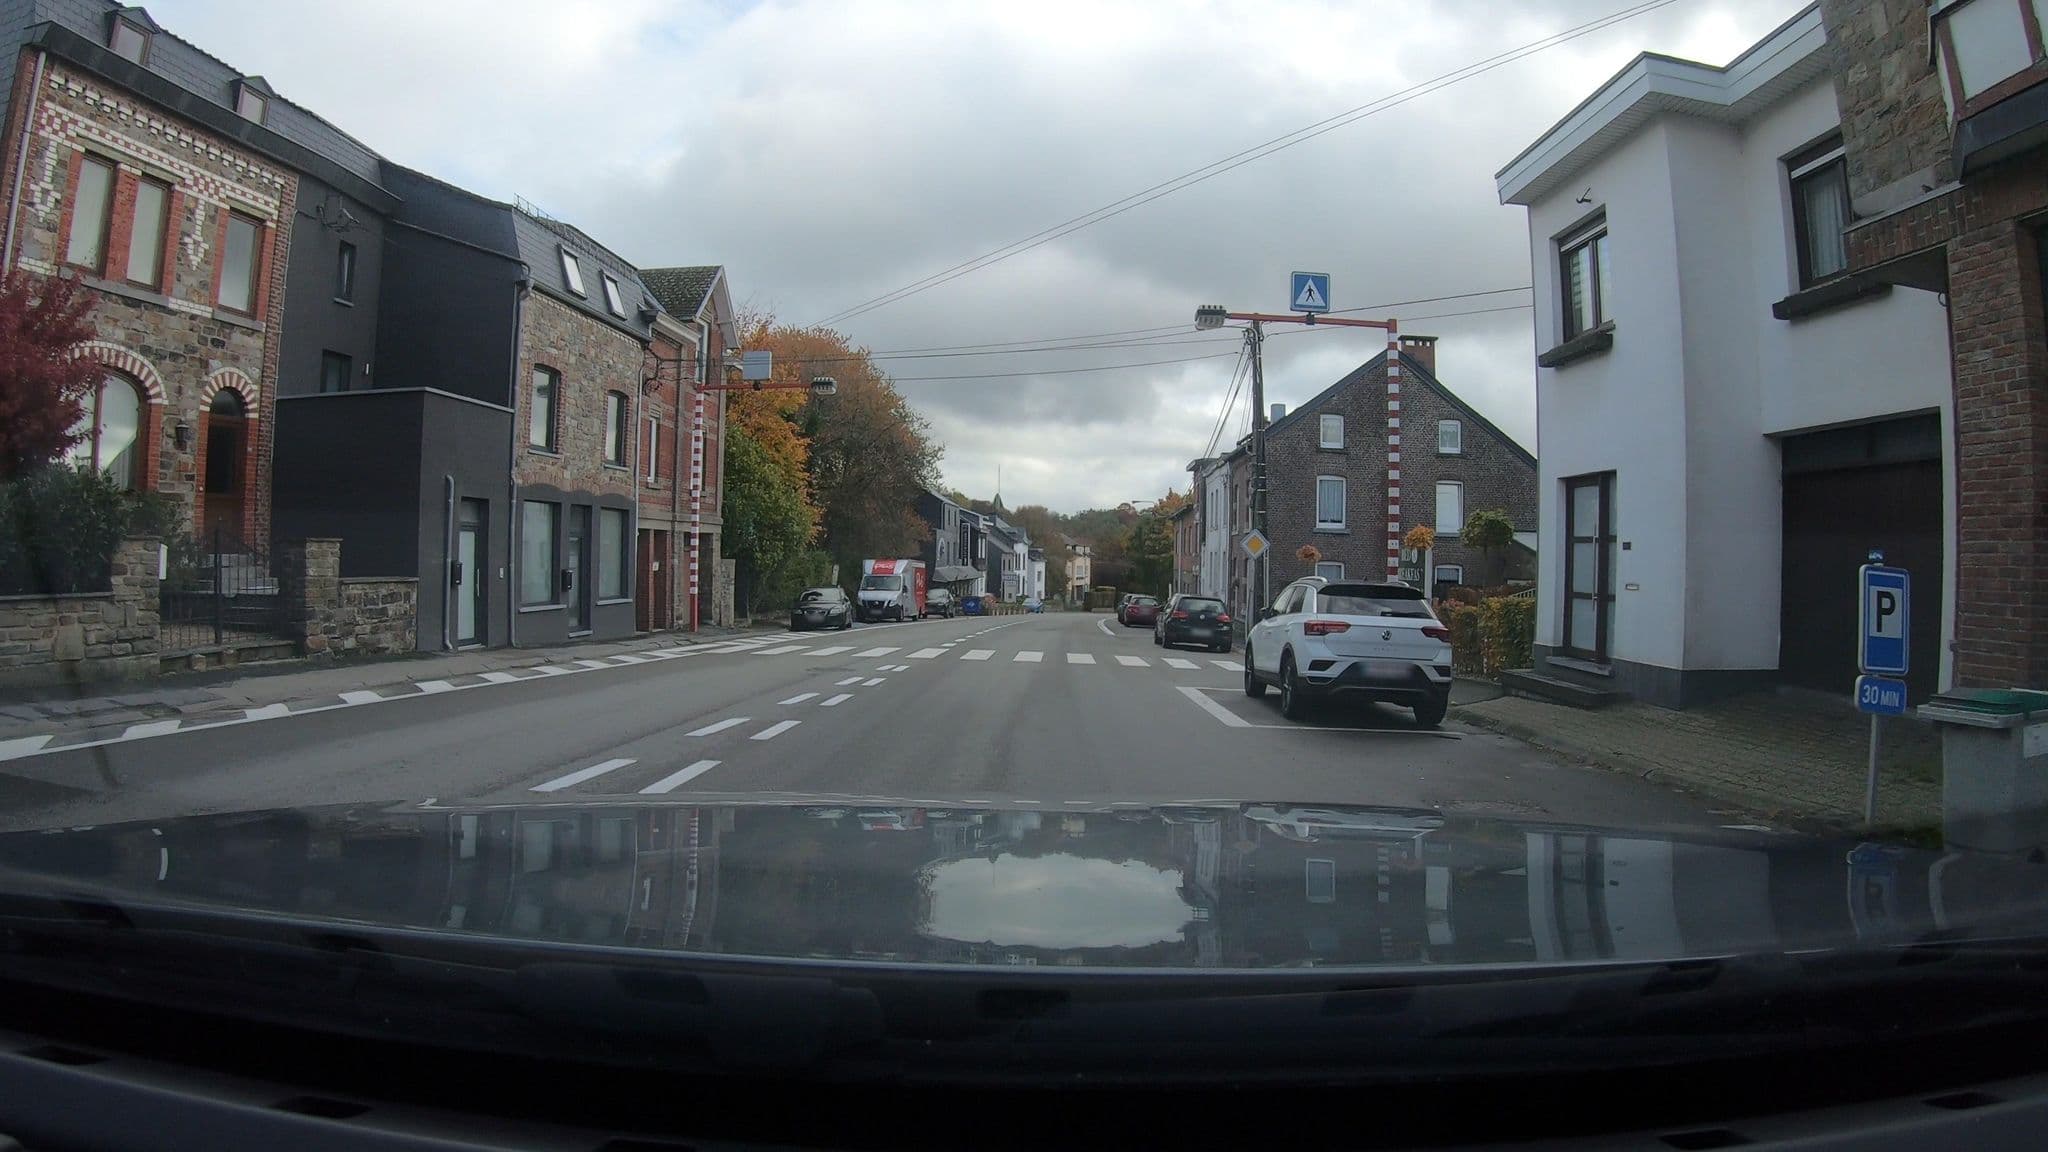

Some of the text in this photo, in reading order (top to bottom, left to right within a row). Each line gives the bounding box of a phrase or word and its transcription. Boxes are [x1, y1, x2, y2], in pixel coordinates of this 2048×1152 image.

[1876, 590, 1896, 633] P
[1862, 684, 1900, 707] 30 MIN
